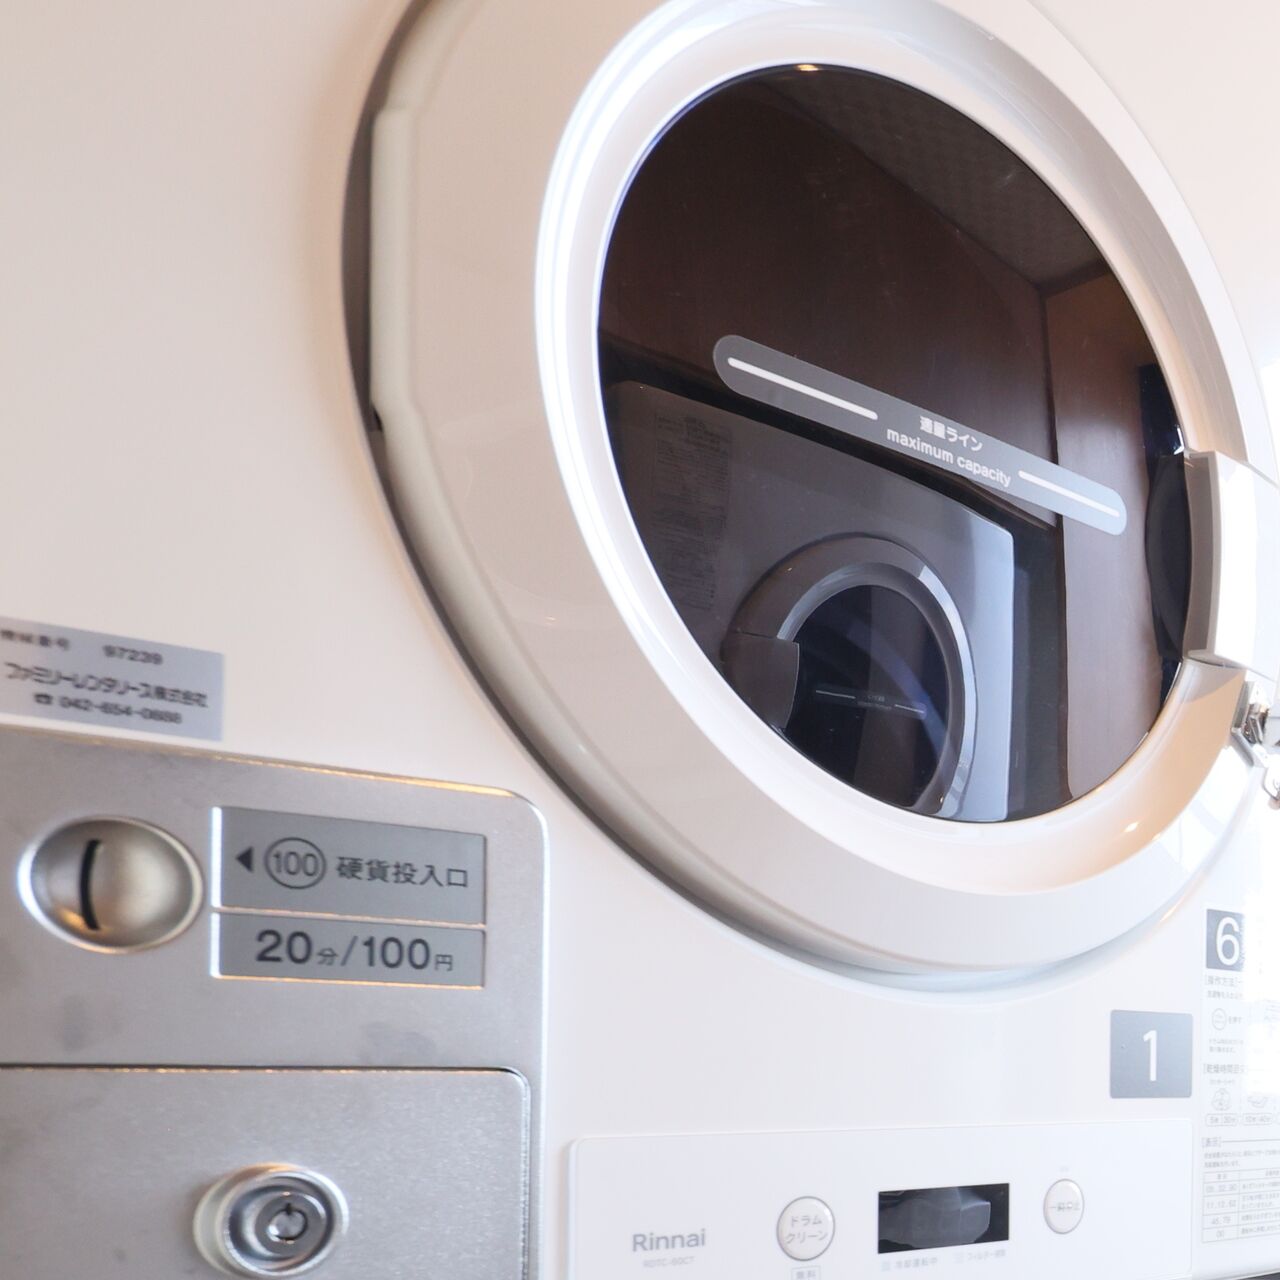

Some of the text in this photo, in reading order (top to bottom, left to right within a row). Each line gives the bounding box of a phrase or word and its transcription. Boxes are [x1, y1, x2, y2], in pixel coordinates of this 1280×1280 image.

[886, 428, 1012, 488] maximum capacity
[272, 850, 471, 890] 100 硬貨投入口
[254, 928, 455, 974] 20分/100円
[1215, 916, 1242, 967] 6
[1142, 1029, 1159, 1083] 1
[631, 1228, 707, 1253] Rinnai
[784, 1229, 830, 1246] クリーン
[788, 1214, 824, 1229] ドラム
